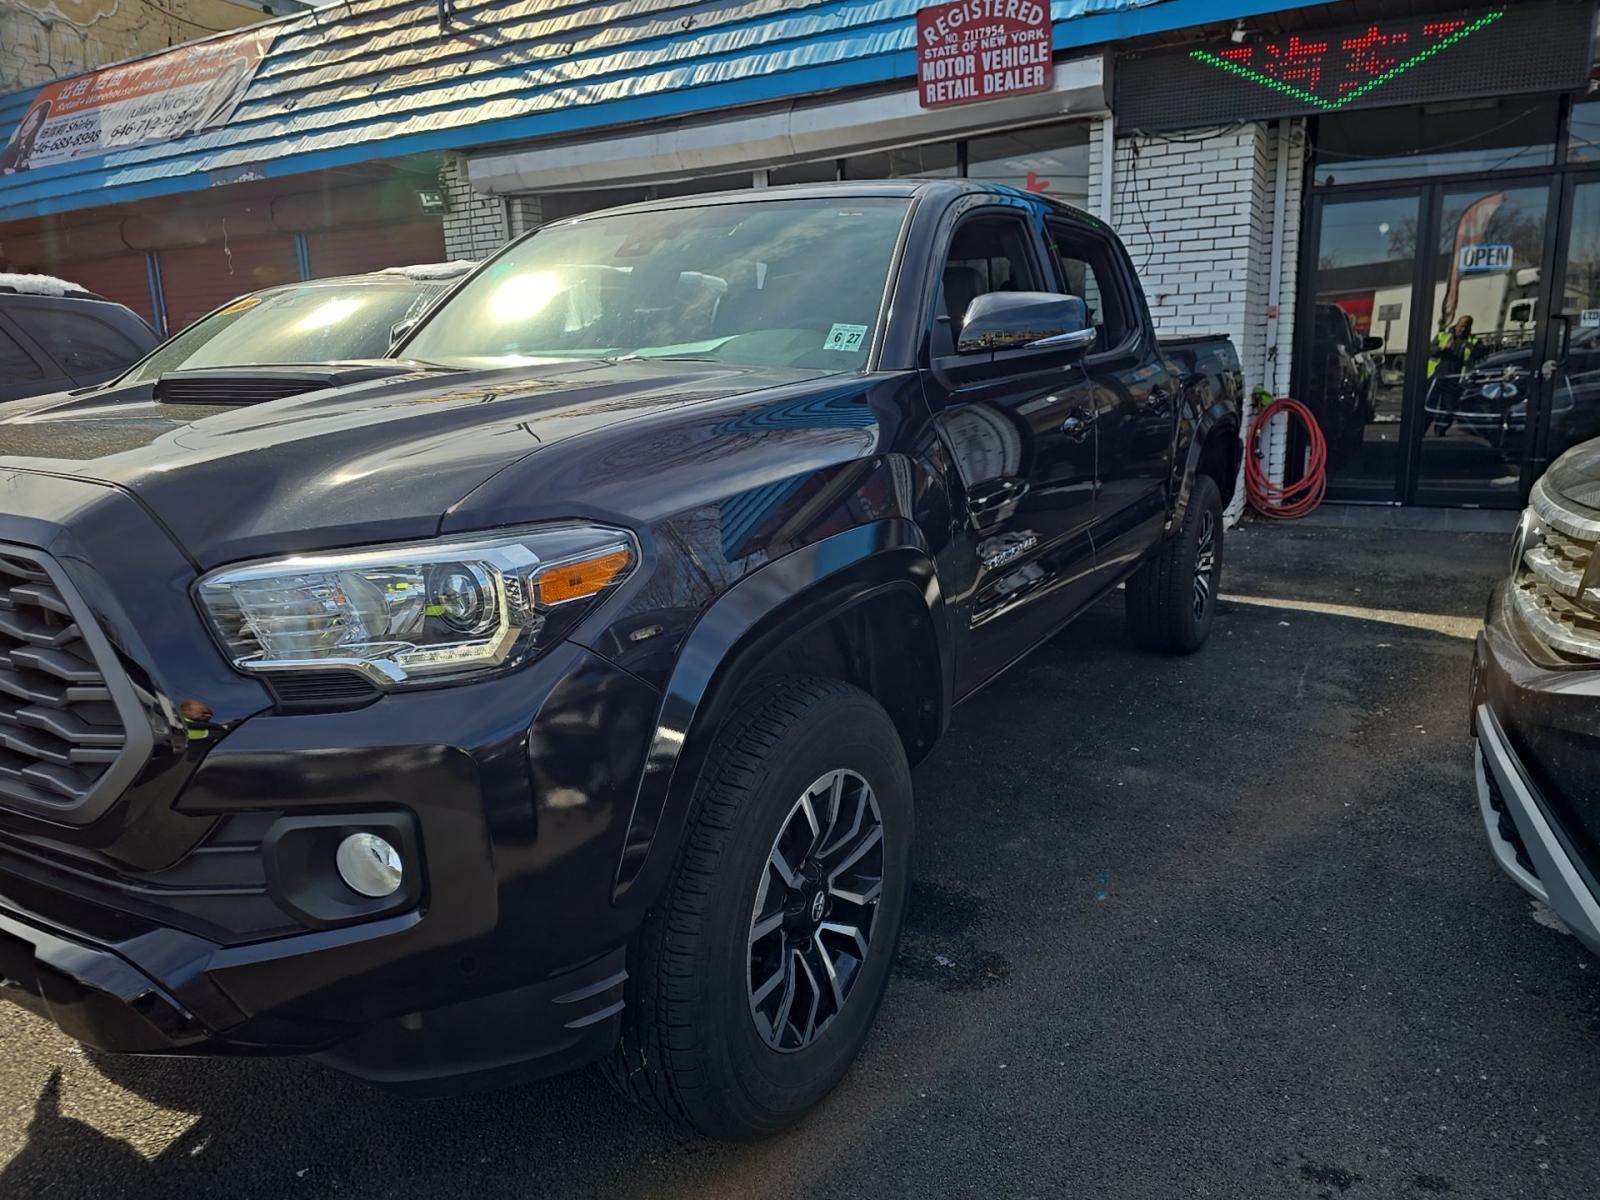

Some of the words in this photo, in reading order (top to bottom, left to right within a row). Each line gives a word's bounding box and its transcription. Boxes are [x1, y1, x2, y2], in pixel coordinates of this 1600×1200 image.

[923, 0, 1044, 46] REGISTERED
[964, 24, 1005, 41] 7117954
[924, 44, 959, 59] STATE
[962, 40, 977, 53] OF
[981, 35, 1007, 50] NEW
[922, 54, 976, 81] MOTOR
[981, 41, 1049, 72] VEHICLE
[926, 77, 979, 103] RETAIL
[983, 65, 1045, 94] DEALER
[1463, 247, 1509, 266] OPEN
[834, 332, 843, 343] 6
[846, 333, 862, 344] 27
